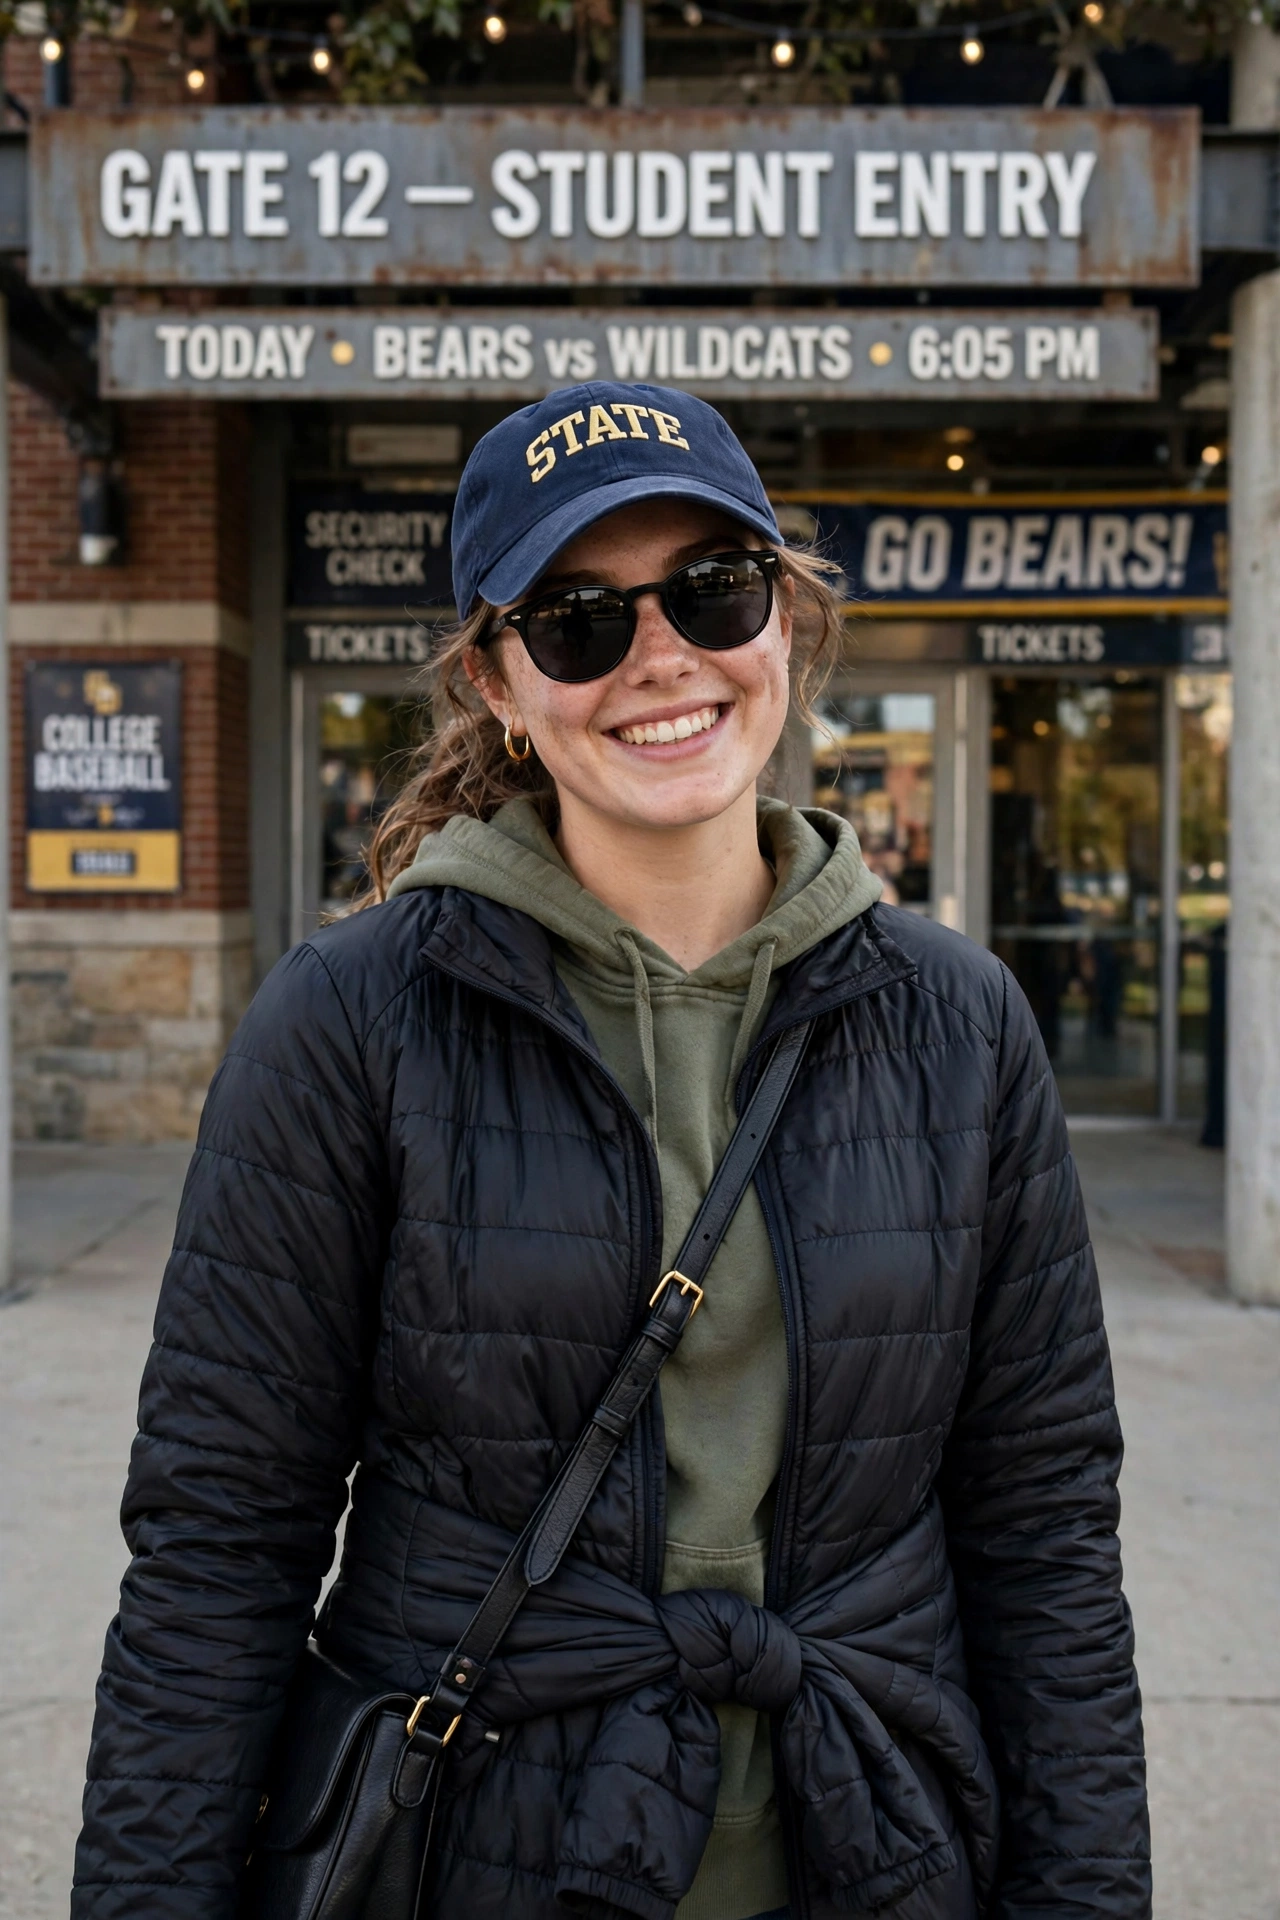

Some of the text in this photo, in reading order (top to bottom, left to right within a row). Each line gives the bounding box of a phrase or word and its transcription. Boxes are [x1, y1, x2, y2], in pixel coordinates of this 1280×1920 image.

[101, 150, 288, 238] GATE
[309, 150, 389, 237] 12
[490, 150, 832, 238] STUDENT
[854, 151, 1096, 238] ENTRY
[157, 325, 314, 379] TODAY
[373, 325, 532, 380] BEARS
[607, 325, 852, 380] WILDCATS
[908, 326, 1013, 380] 6:05
[1025, 327, 1099, 379] PM
[525, 403, 690, 484] STATE
[305, 511, 448, 548] SECURITY
[326, 551, 426, 586] CHECK
[864, 514, 952, 591] GO
[962, 513, 1193, 590] BEARS!
[306, 626, 430, 662] TICKETS
[979, 624, 1104, 661] TICKETS
[42, 714, 163, 752] COLLEGE
[34, 751, 170, 792] BASEBALL
